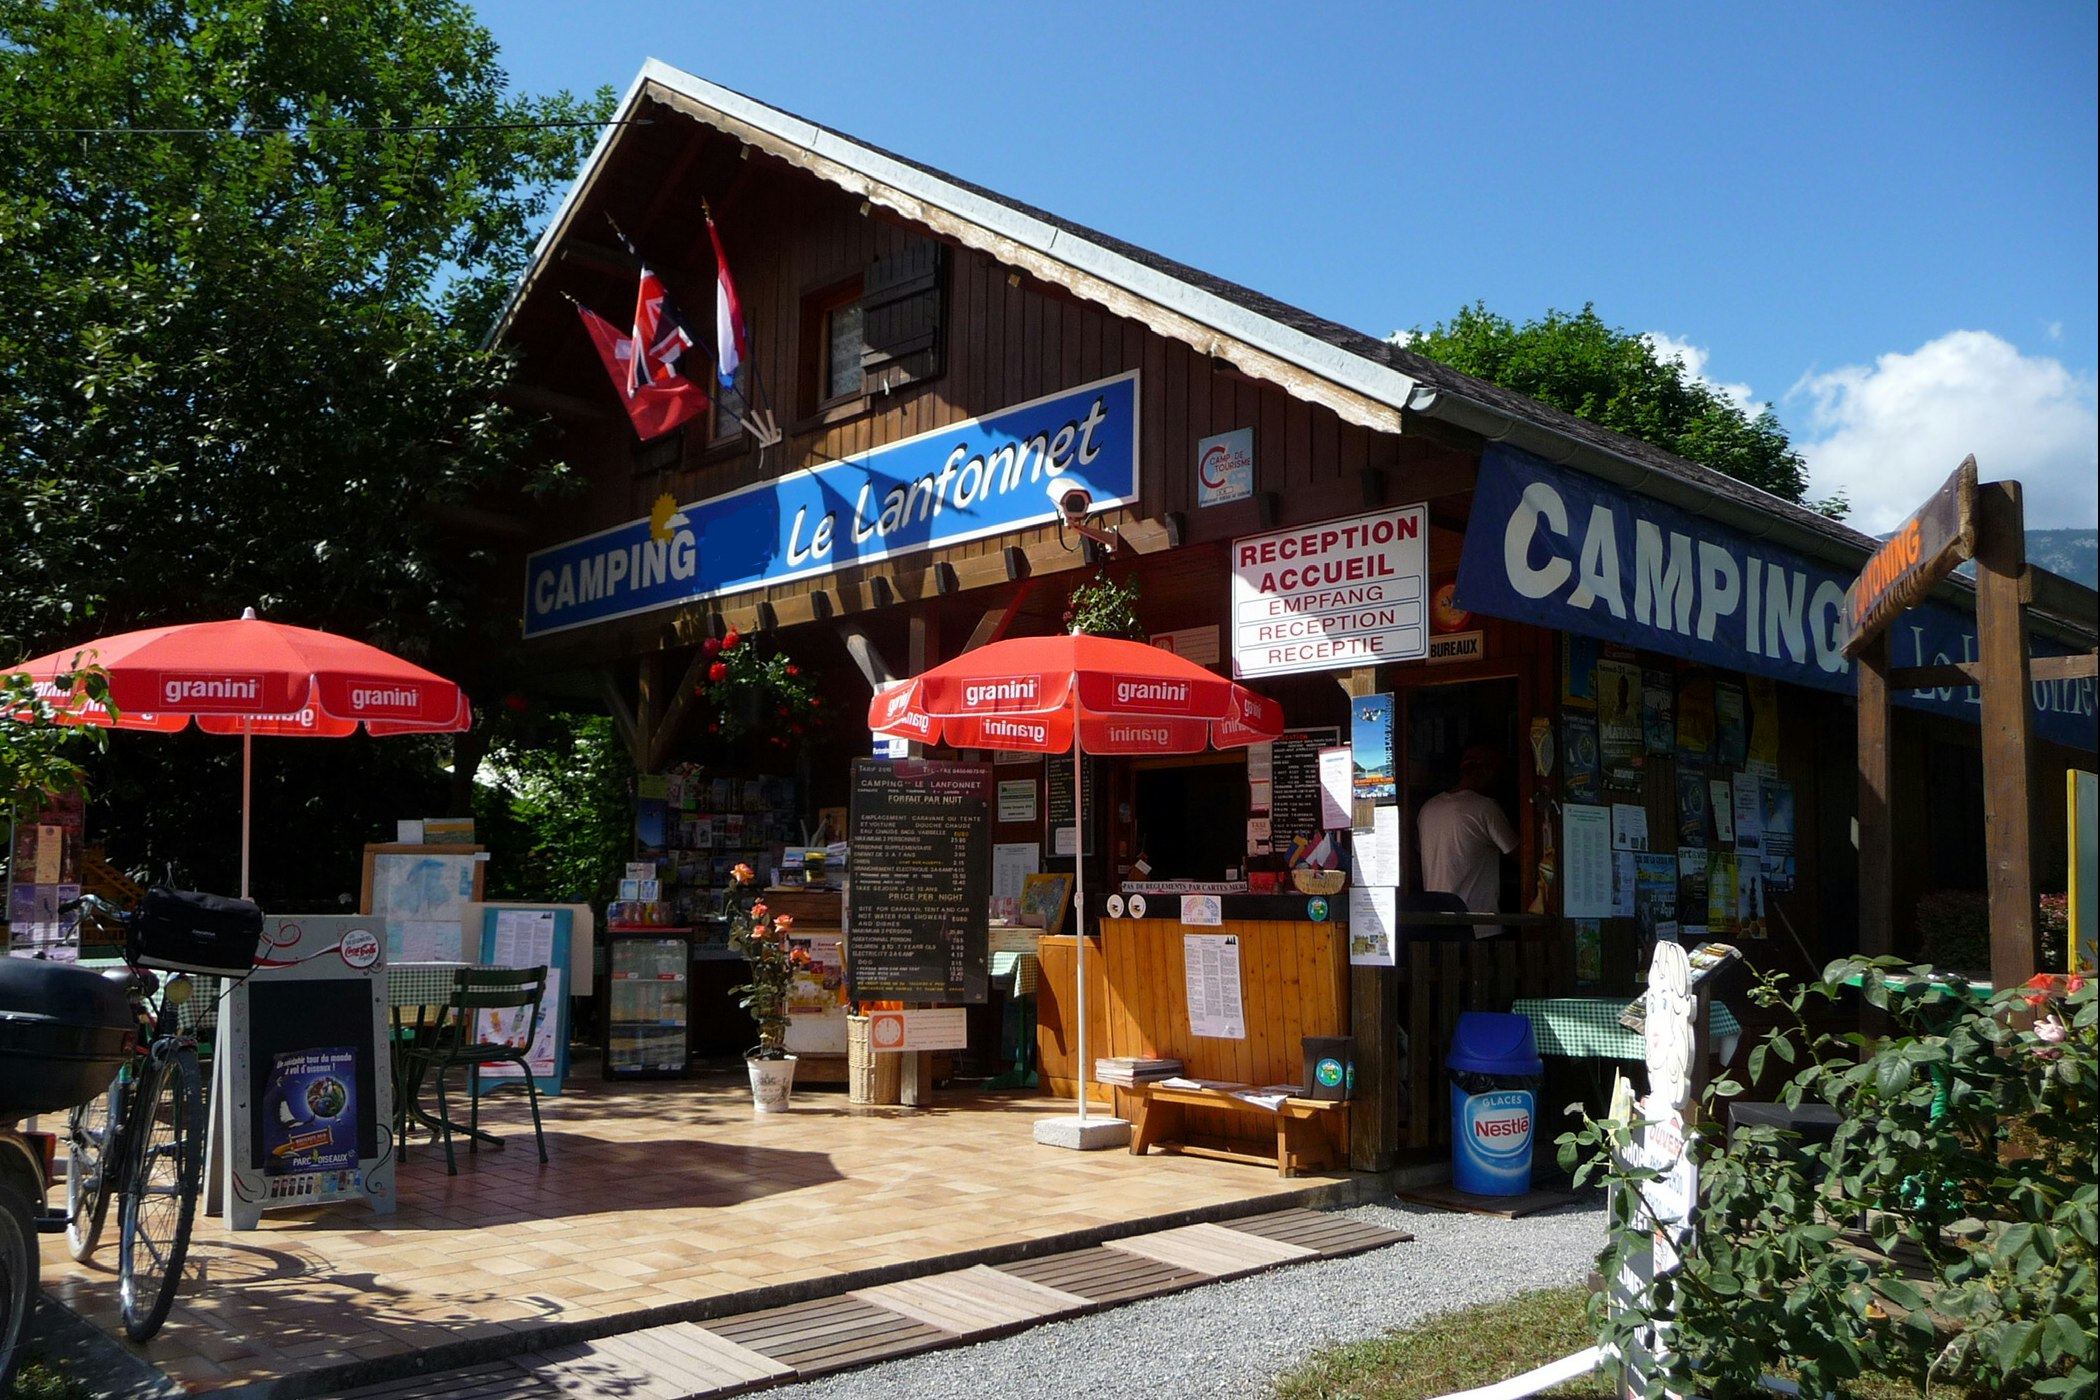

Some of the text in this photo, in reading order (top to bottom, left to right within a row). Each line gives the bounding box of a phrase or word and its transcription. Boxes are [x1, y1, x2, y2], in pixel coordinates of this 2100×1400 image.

[1209, 450, 1244, 466] CAMP DE
[1214, 458, 1252, 473] TOURISME
[786, 399, 1108, 567] Le Lanfonnet
[1239, 515, 1419, 569] RECEPTION
[533, 527, 697, 616] CAMPING
[1259, 553, 1396, 594] ACCUEIL
[1503, 480, 1852, 676] CAMPING
[1268, 585, 1384, 616] EMPFANG
[1258, 609, 1396, 641] RECEPTION
[1268, 636, 1385, 664] RECEPTIE
[1430, 637, 1478, 659] BUREAUX
[165, 678, 258, 704] granini
[352, 686, 418, 711] granini
[966, 681, 1038, 705] granini
[1117, 680, 1187, 702] granini
[860, 779, 982, 789] CAMPING LE LANFONNET
[887, 794, 964, 805] FORFAIT PAR NUIT
[888, 892, 964, 902] PRICE PER NIGHT
[1136, 882, 1145, 890] DE
[1145, 882, 1187, 890] REGLEMENTS
[1188, 883, 1201, 891] PAR
[1201, 883, 1228, 892] CARTES
[1482, 1095, 1523, 1107] GLACES
[292, 1153, 348, 1167] PARC OISEAUX
